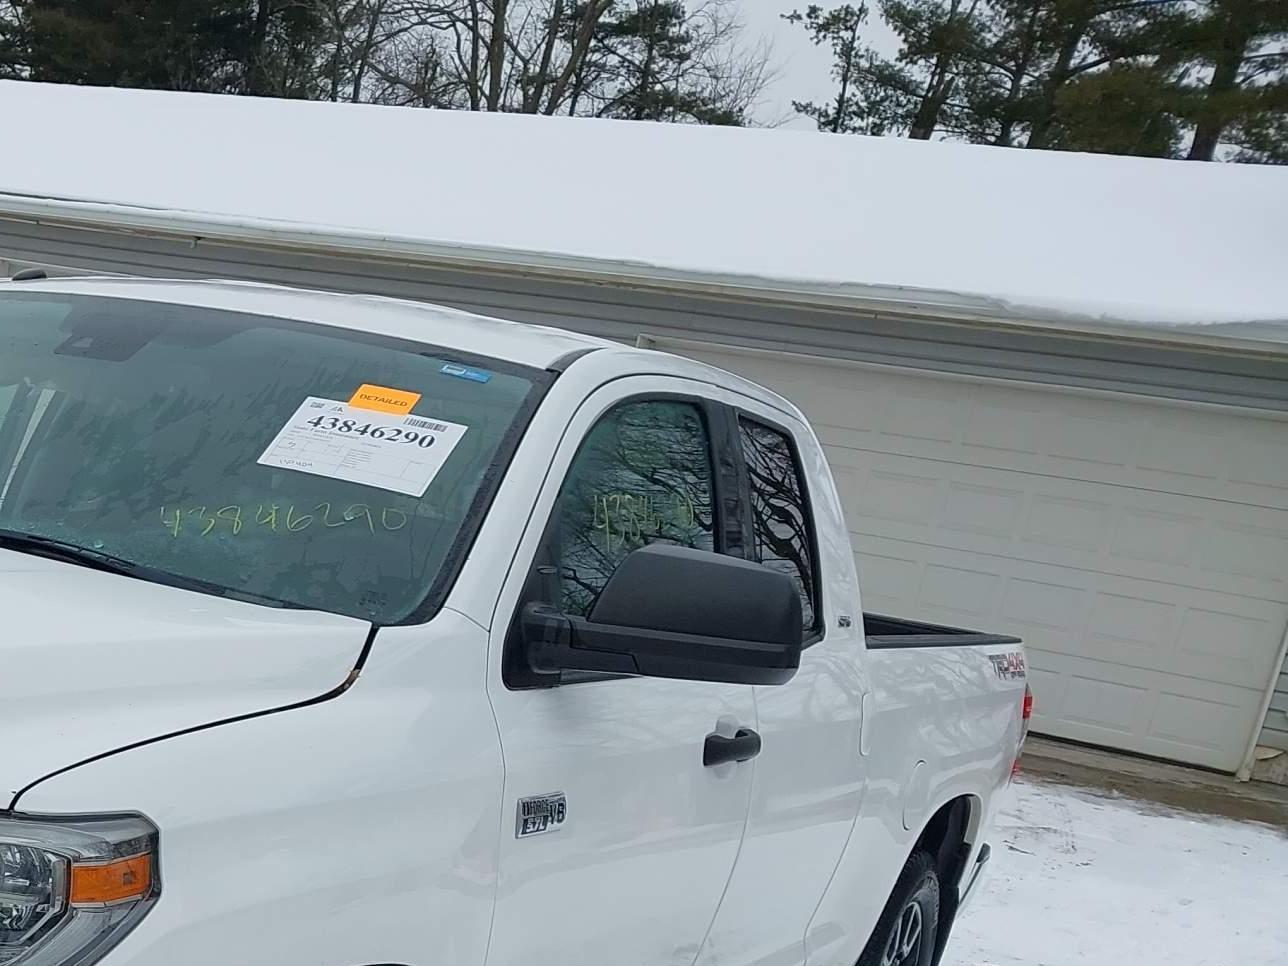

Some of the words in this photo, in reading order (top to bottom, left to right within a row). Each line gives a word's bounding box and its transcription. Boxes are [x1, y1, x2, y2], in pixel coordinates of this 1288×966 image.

[359, 393, 408, 408] DETAILED
[306, 415, 435, 449] 43846290
[160, 501, 408, 538] 43846290
